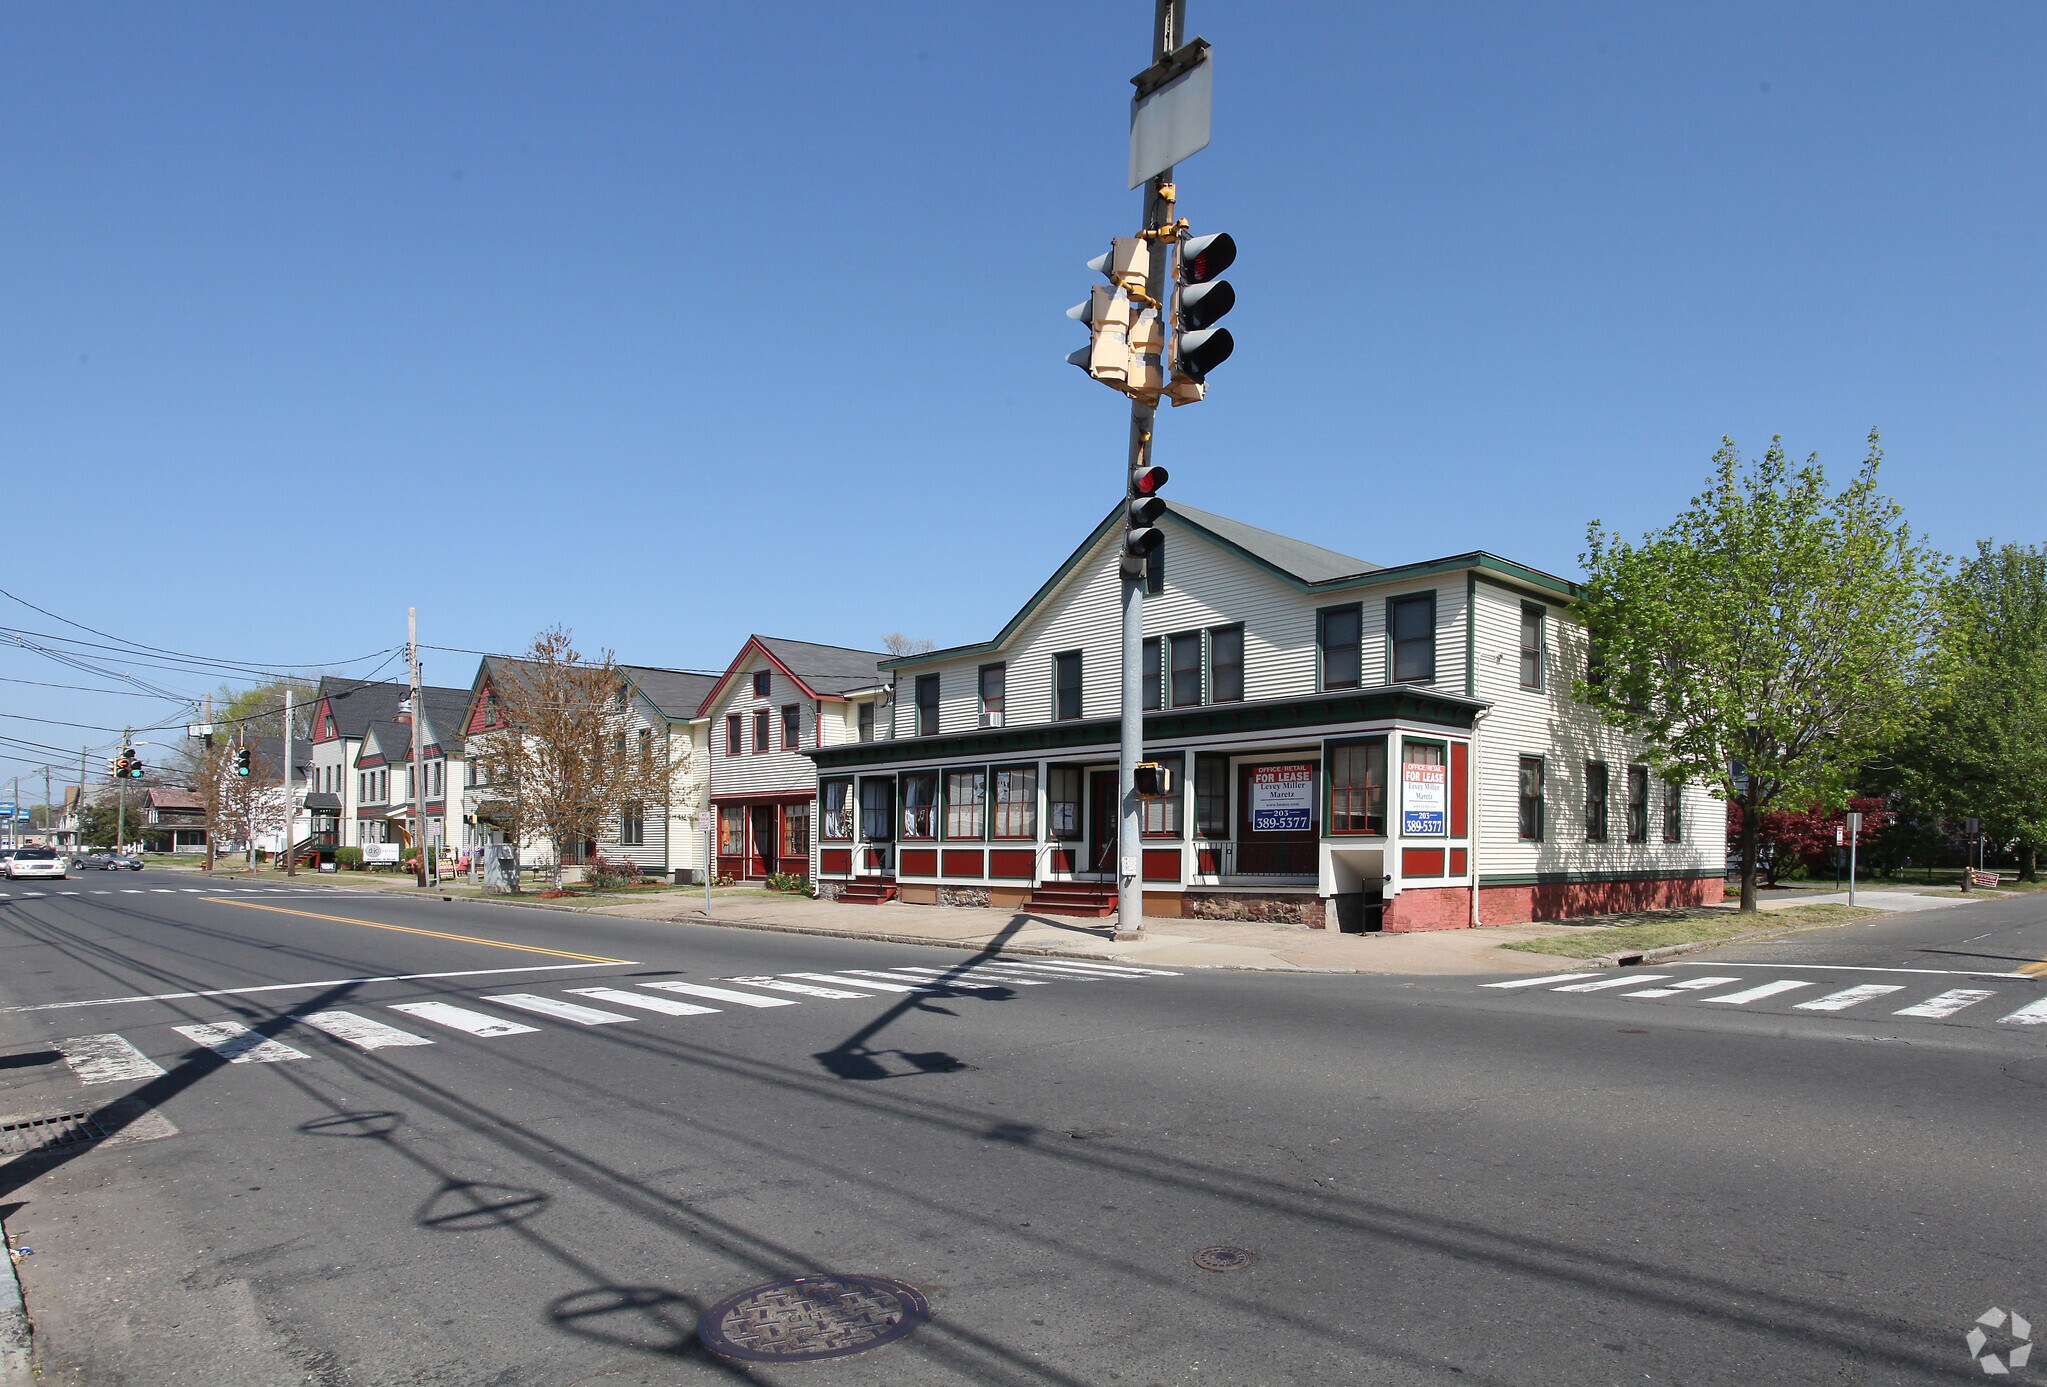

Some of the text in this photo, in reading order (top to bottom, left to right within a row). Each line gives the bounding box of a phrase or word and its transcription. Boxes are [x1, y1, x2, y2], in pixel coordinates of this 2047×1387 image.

[1256, 772, 1309, 783] FOR LEASE
[1405, 771, 1444, 783] FOR LEASE
[1260, 783, 1281, 791] Levey
[1256, 817, 1307, 828] 389-5377
[1406, 820, 1441, 832] 389-5377
